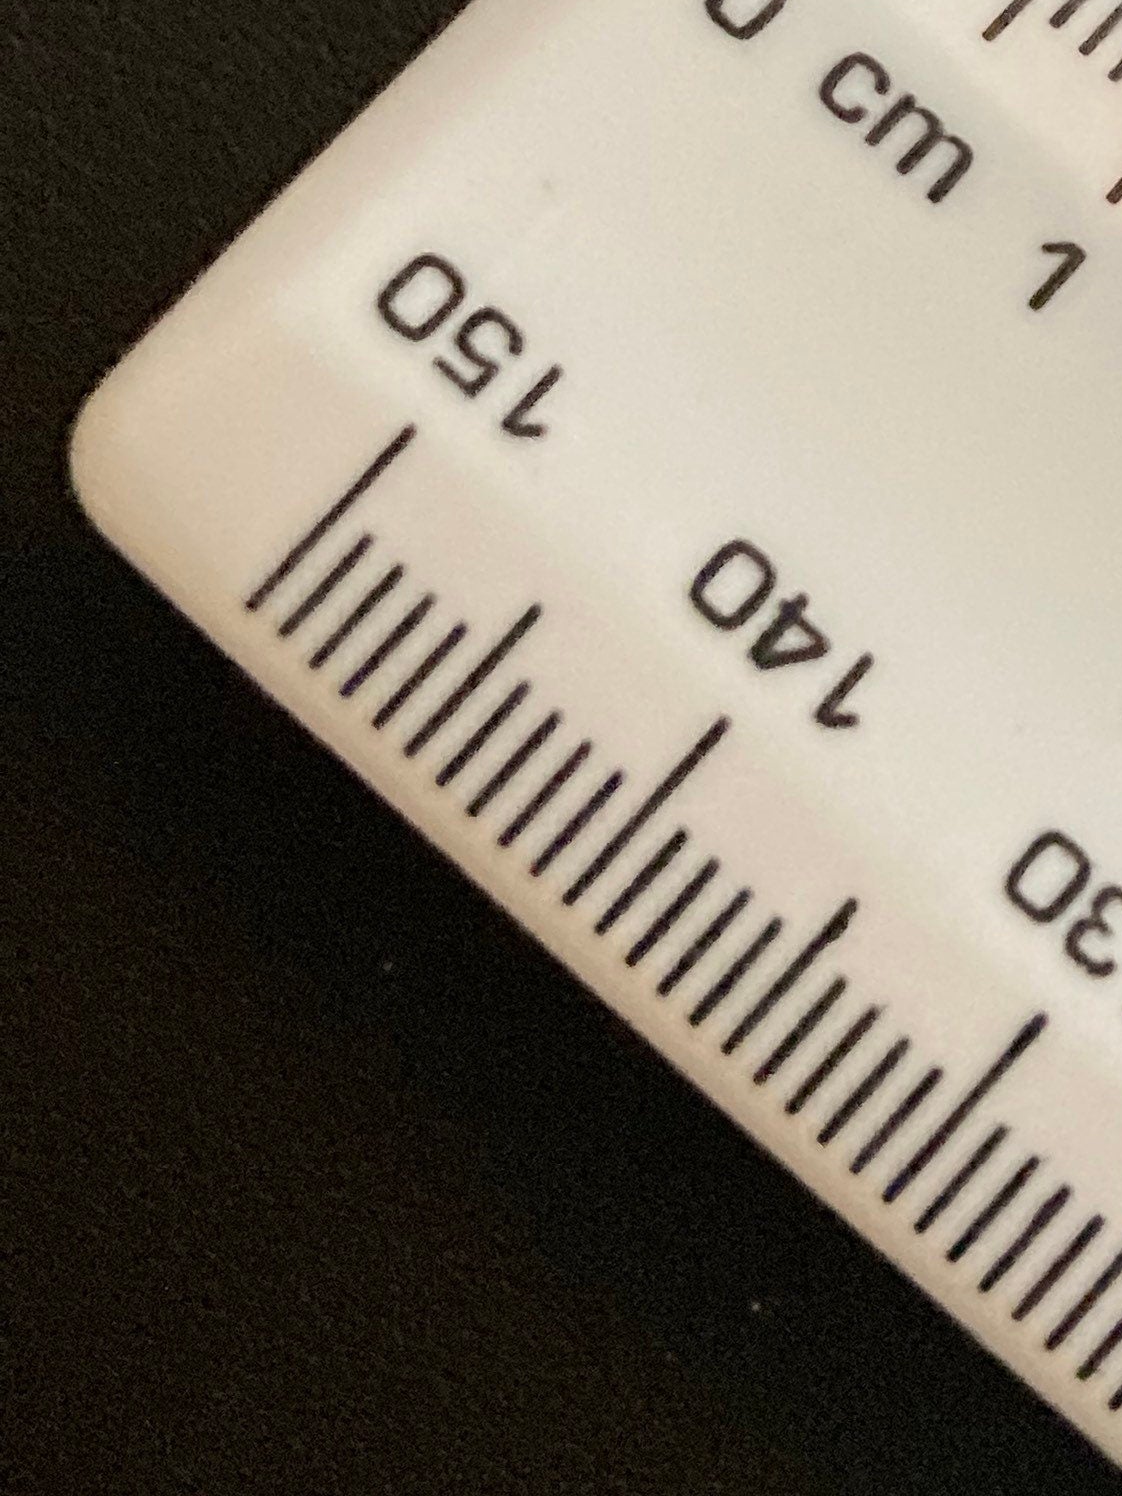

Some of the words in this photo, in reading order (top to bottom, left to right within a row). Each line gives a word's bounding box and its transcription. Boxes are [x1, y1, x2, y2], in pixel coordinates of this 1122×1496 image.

[816, 50, 976, 206] cm
[1026, 239, 1089, 314] 1
[375, 252, 563, 440] 150
[686, 538, 875, 732] 140
